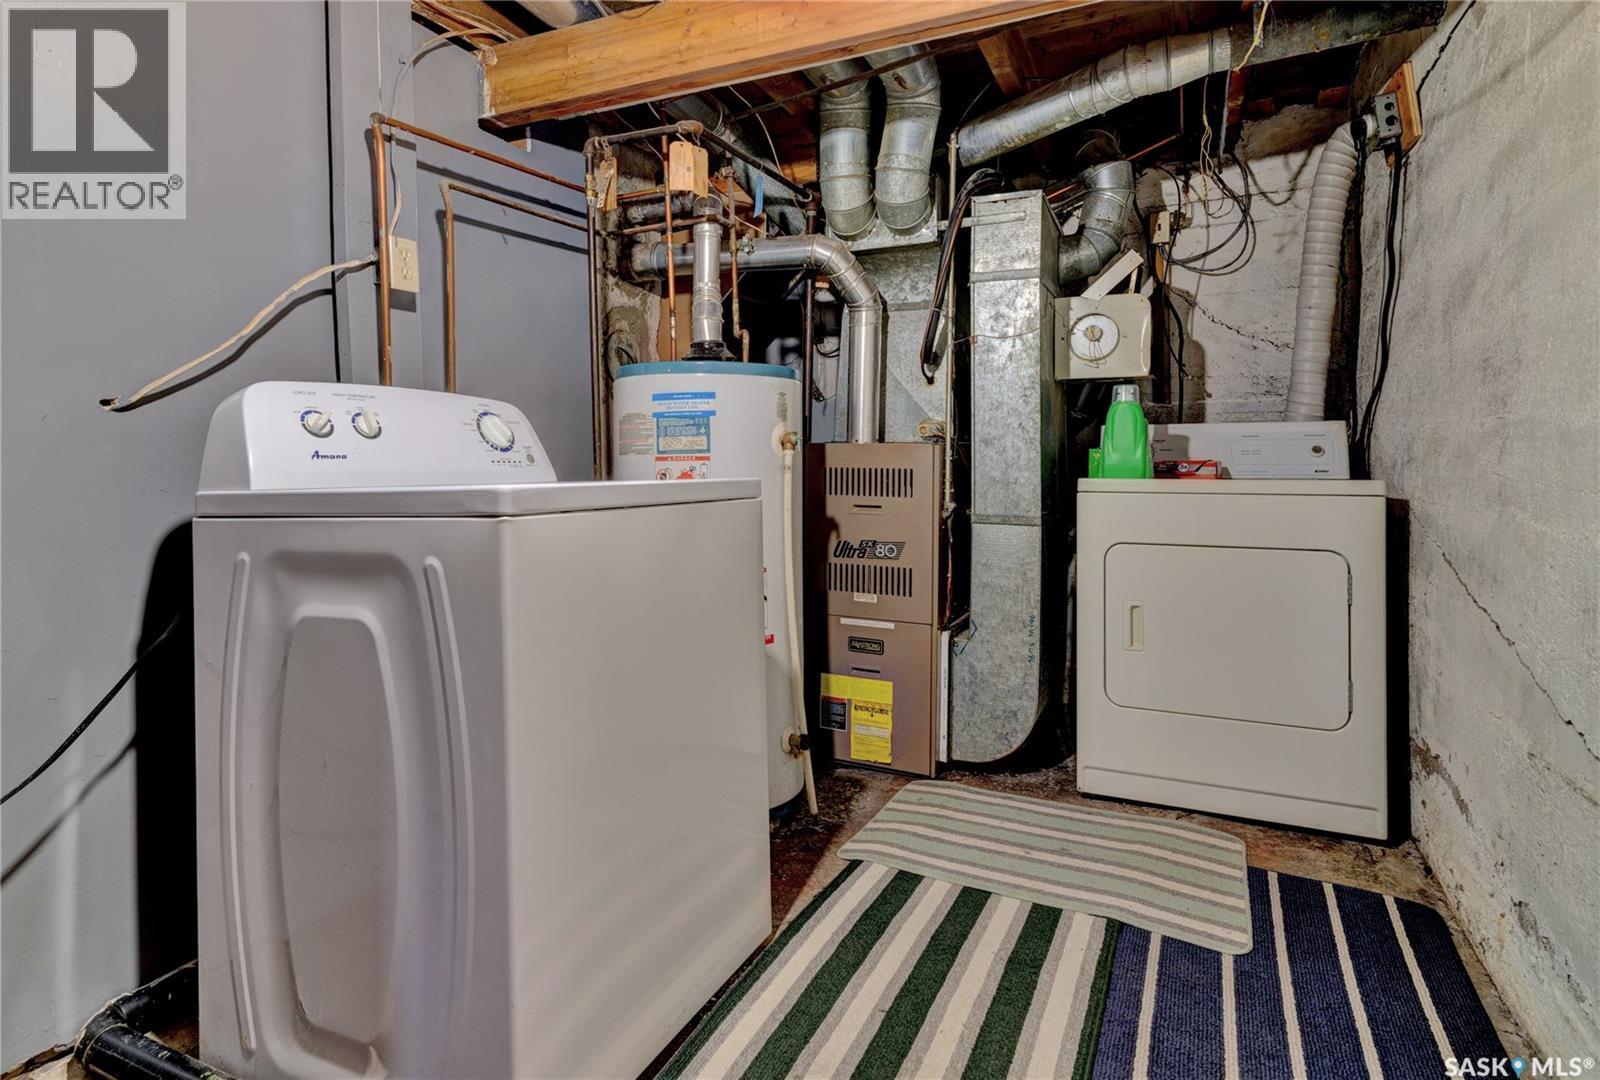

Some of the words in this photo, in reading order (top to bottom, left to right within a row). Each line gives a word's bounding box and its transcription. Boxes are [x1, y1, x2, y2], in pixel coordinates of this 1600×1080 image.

[311, 450, 347, 460] Amana
[833, 540, 868, 559] Ultra
[861, 540, 874, 548] SX
[875, 544, 897, 557] 80
